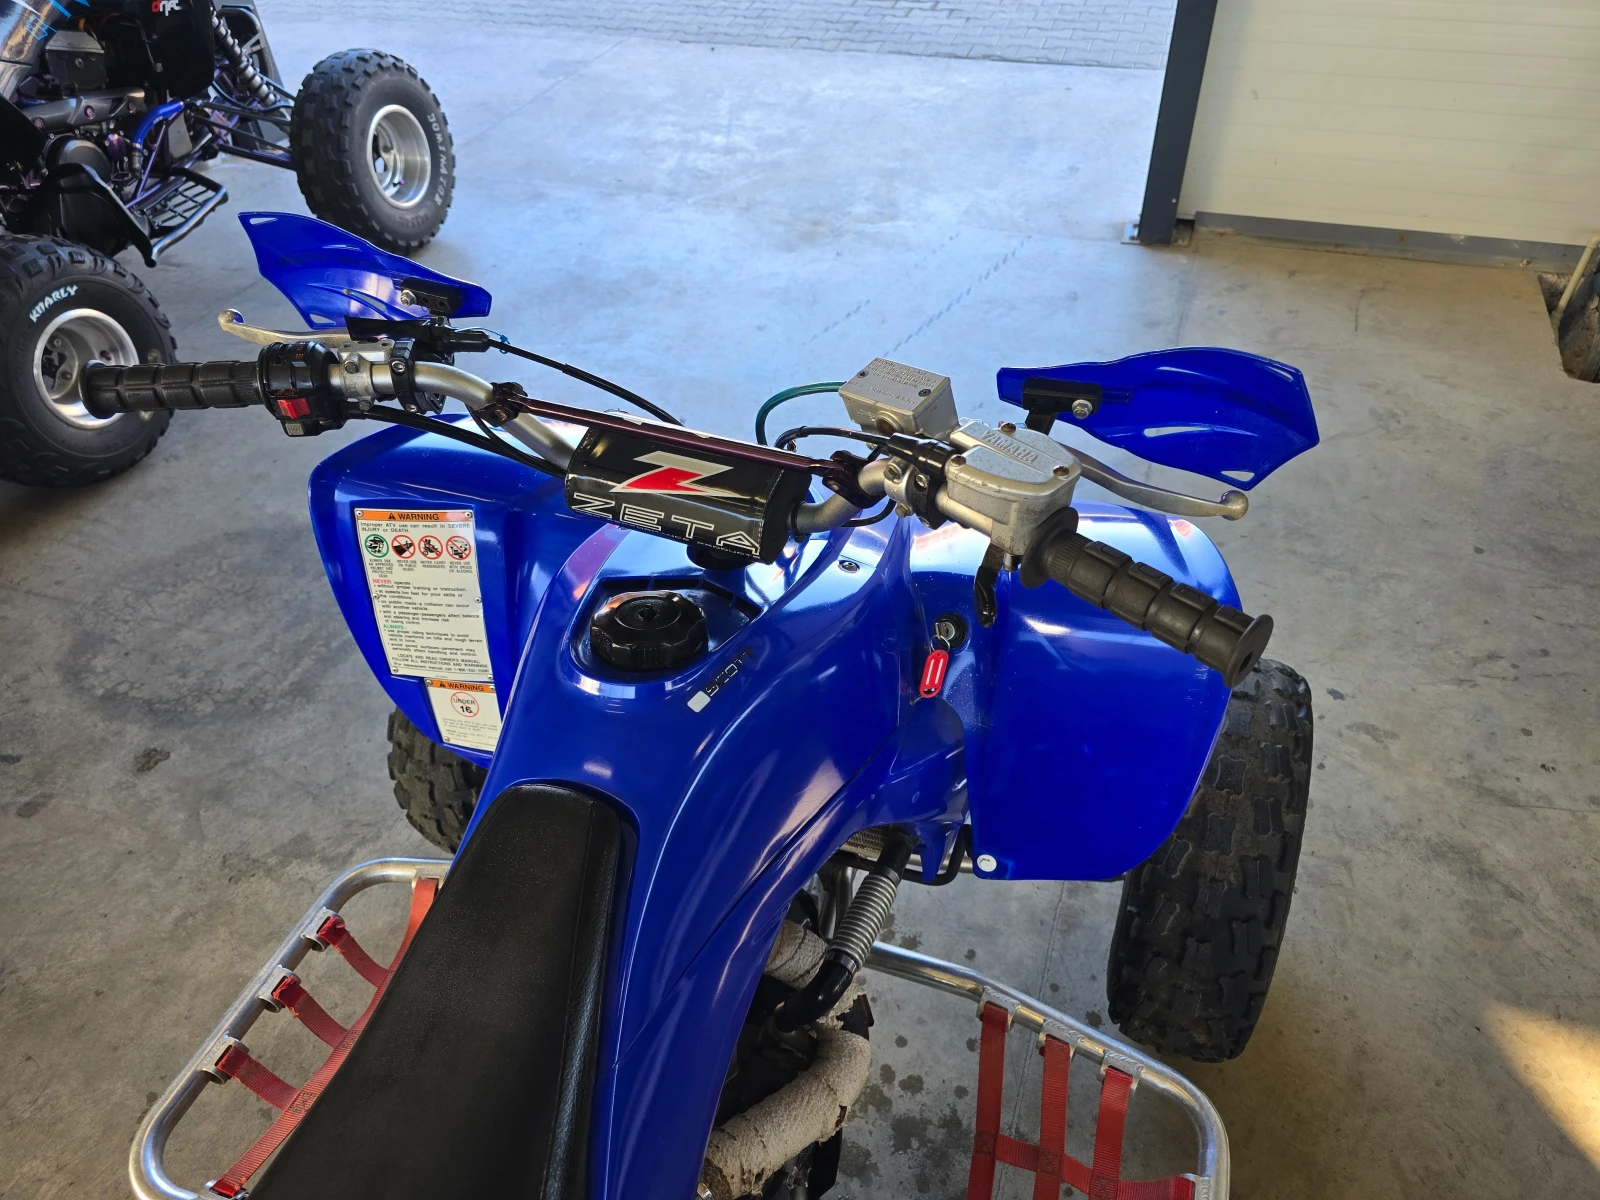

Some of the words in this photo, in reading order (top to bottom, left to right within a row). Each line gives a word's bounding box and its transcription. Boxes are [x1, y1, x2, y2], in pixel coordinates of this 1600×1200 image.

[28, 284, 78, 323] KNARLY
[980, 430, 1038, 464] YAMAHA
[571, 492, 760, 556] ZETA
[448, 683, 484, 691] WARNING
